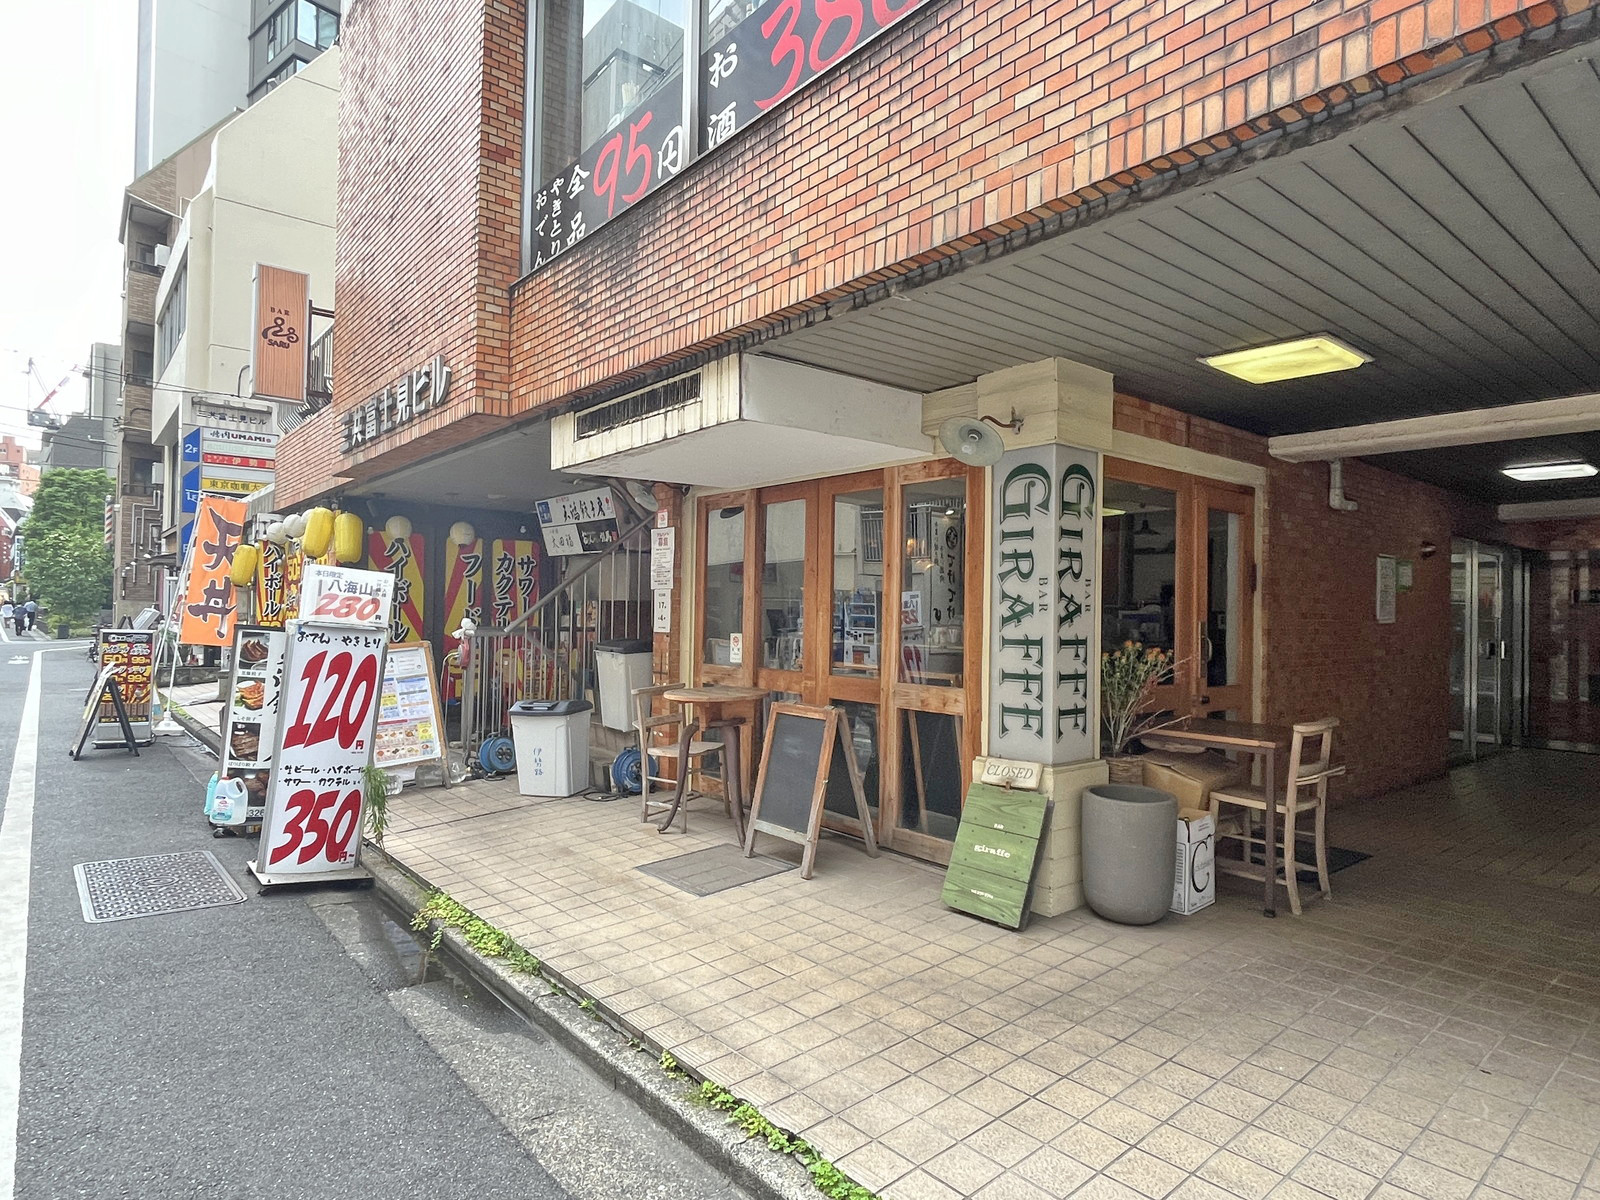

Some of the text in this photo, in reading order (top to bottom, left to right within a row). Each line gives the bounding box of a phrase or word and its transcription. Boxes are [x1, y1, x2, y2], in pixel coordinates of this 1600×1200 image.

[708, 42, 738, 150] お酒
[535, 190, 548, 269] おでん
[550, 177, 564, 255] やきとり
[566, 164, 590, 247] 全品
[267, 338, 290, 349] SARU
[271, 306, 290, 316] BAR
[185, 444, 198, 453] 2F
[262, 542, 284, 618] ハイボール
[328, 579, 373, 596] 八海山
[460, 554, 482, 627] フード
[517, 555, 536, 622] サワー
[997, 462, 1052, 740] GIRAFFE
[1038, 576, 1049, 613] BAR
[1056, 462, 1096, 743] GIRAFFE
[1084, 578, 1092, 613] BAR
[986, 763, 1034, 780] CLOSED
[973, 844, 1012, 859] giraffe
